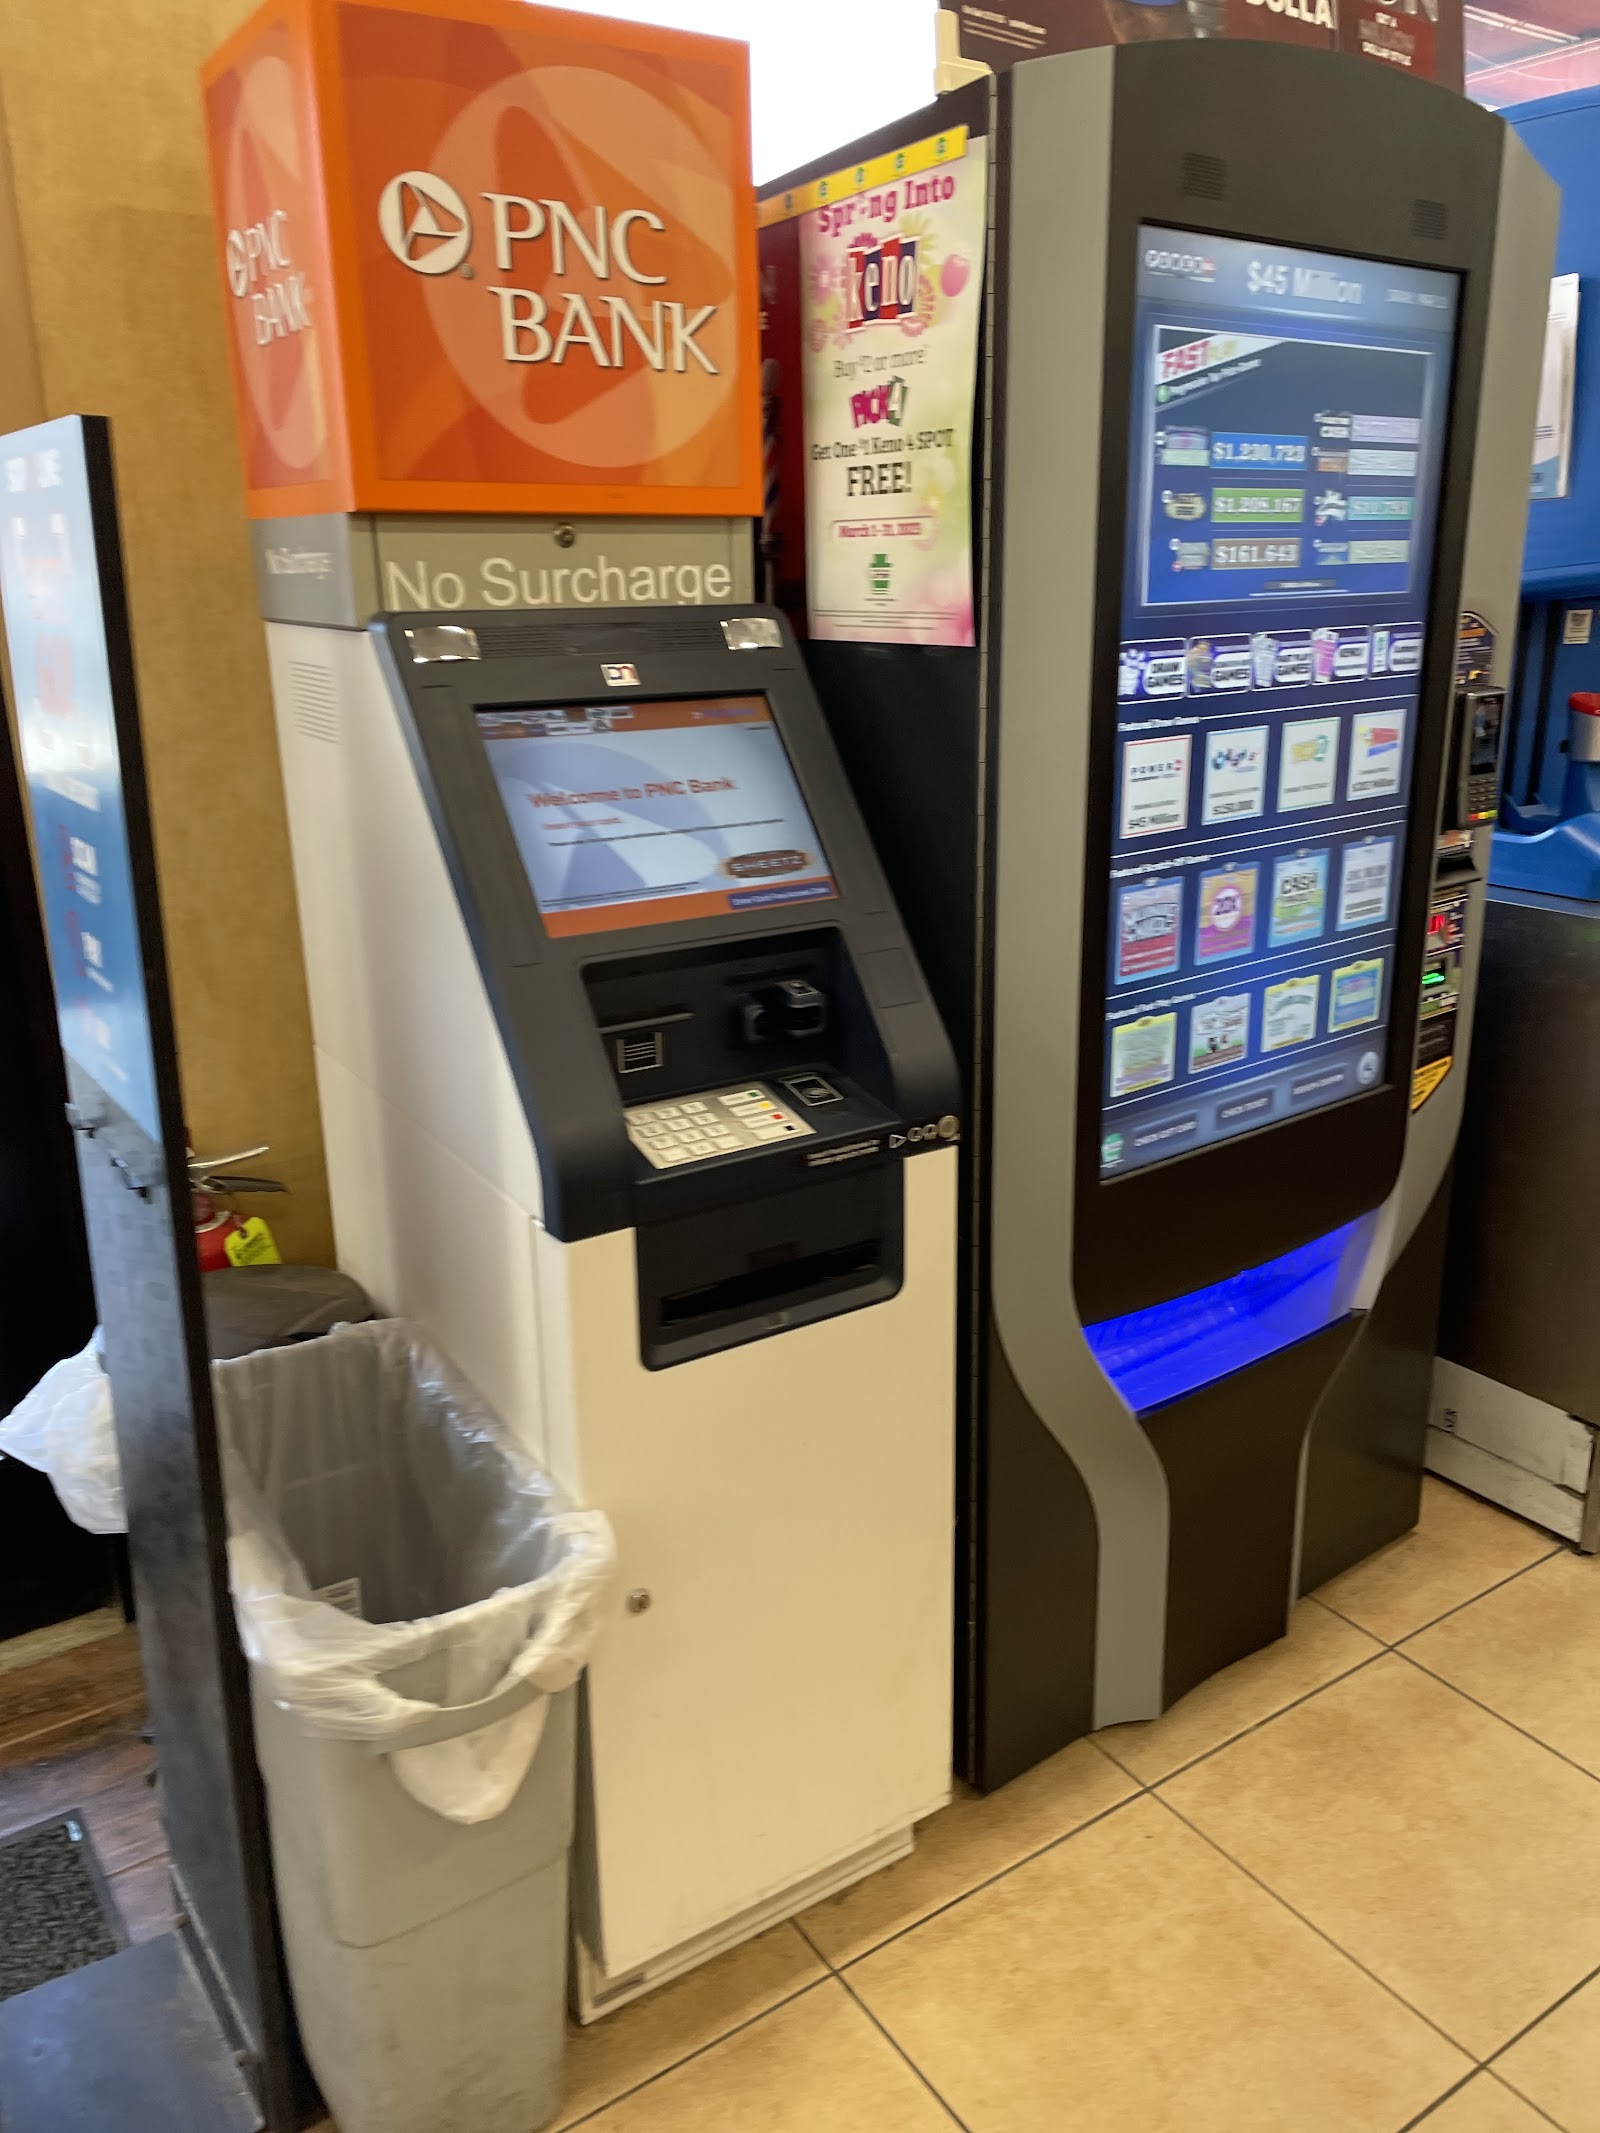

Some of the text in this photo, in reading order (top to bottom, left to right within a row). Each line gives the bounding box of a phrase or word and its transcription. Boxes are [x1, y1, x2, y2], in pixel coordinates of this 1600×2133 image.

[818, 175, 956, 237] Spring Into
[244, 209, 291, 282] PNC
[481, 192, 668, 285] PNC
[488, 286, 718, 375] BANK
[846, 461, 912, 497] FREE!
[385, 560, 465, 610] No
[481, 555, 733, 608] Surcharge
[528, 778, 738, 808] Welcome to PNC Bank
